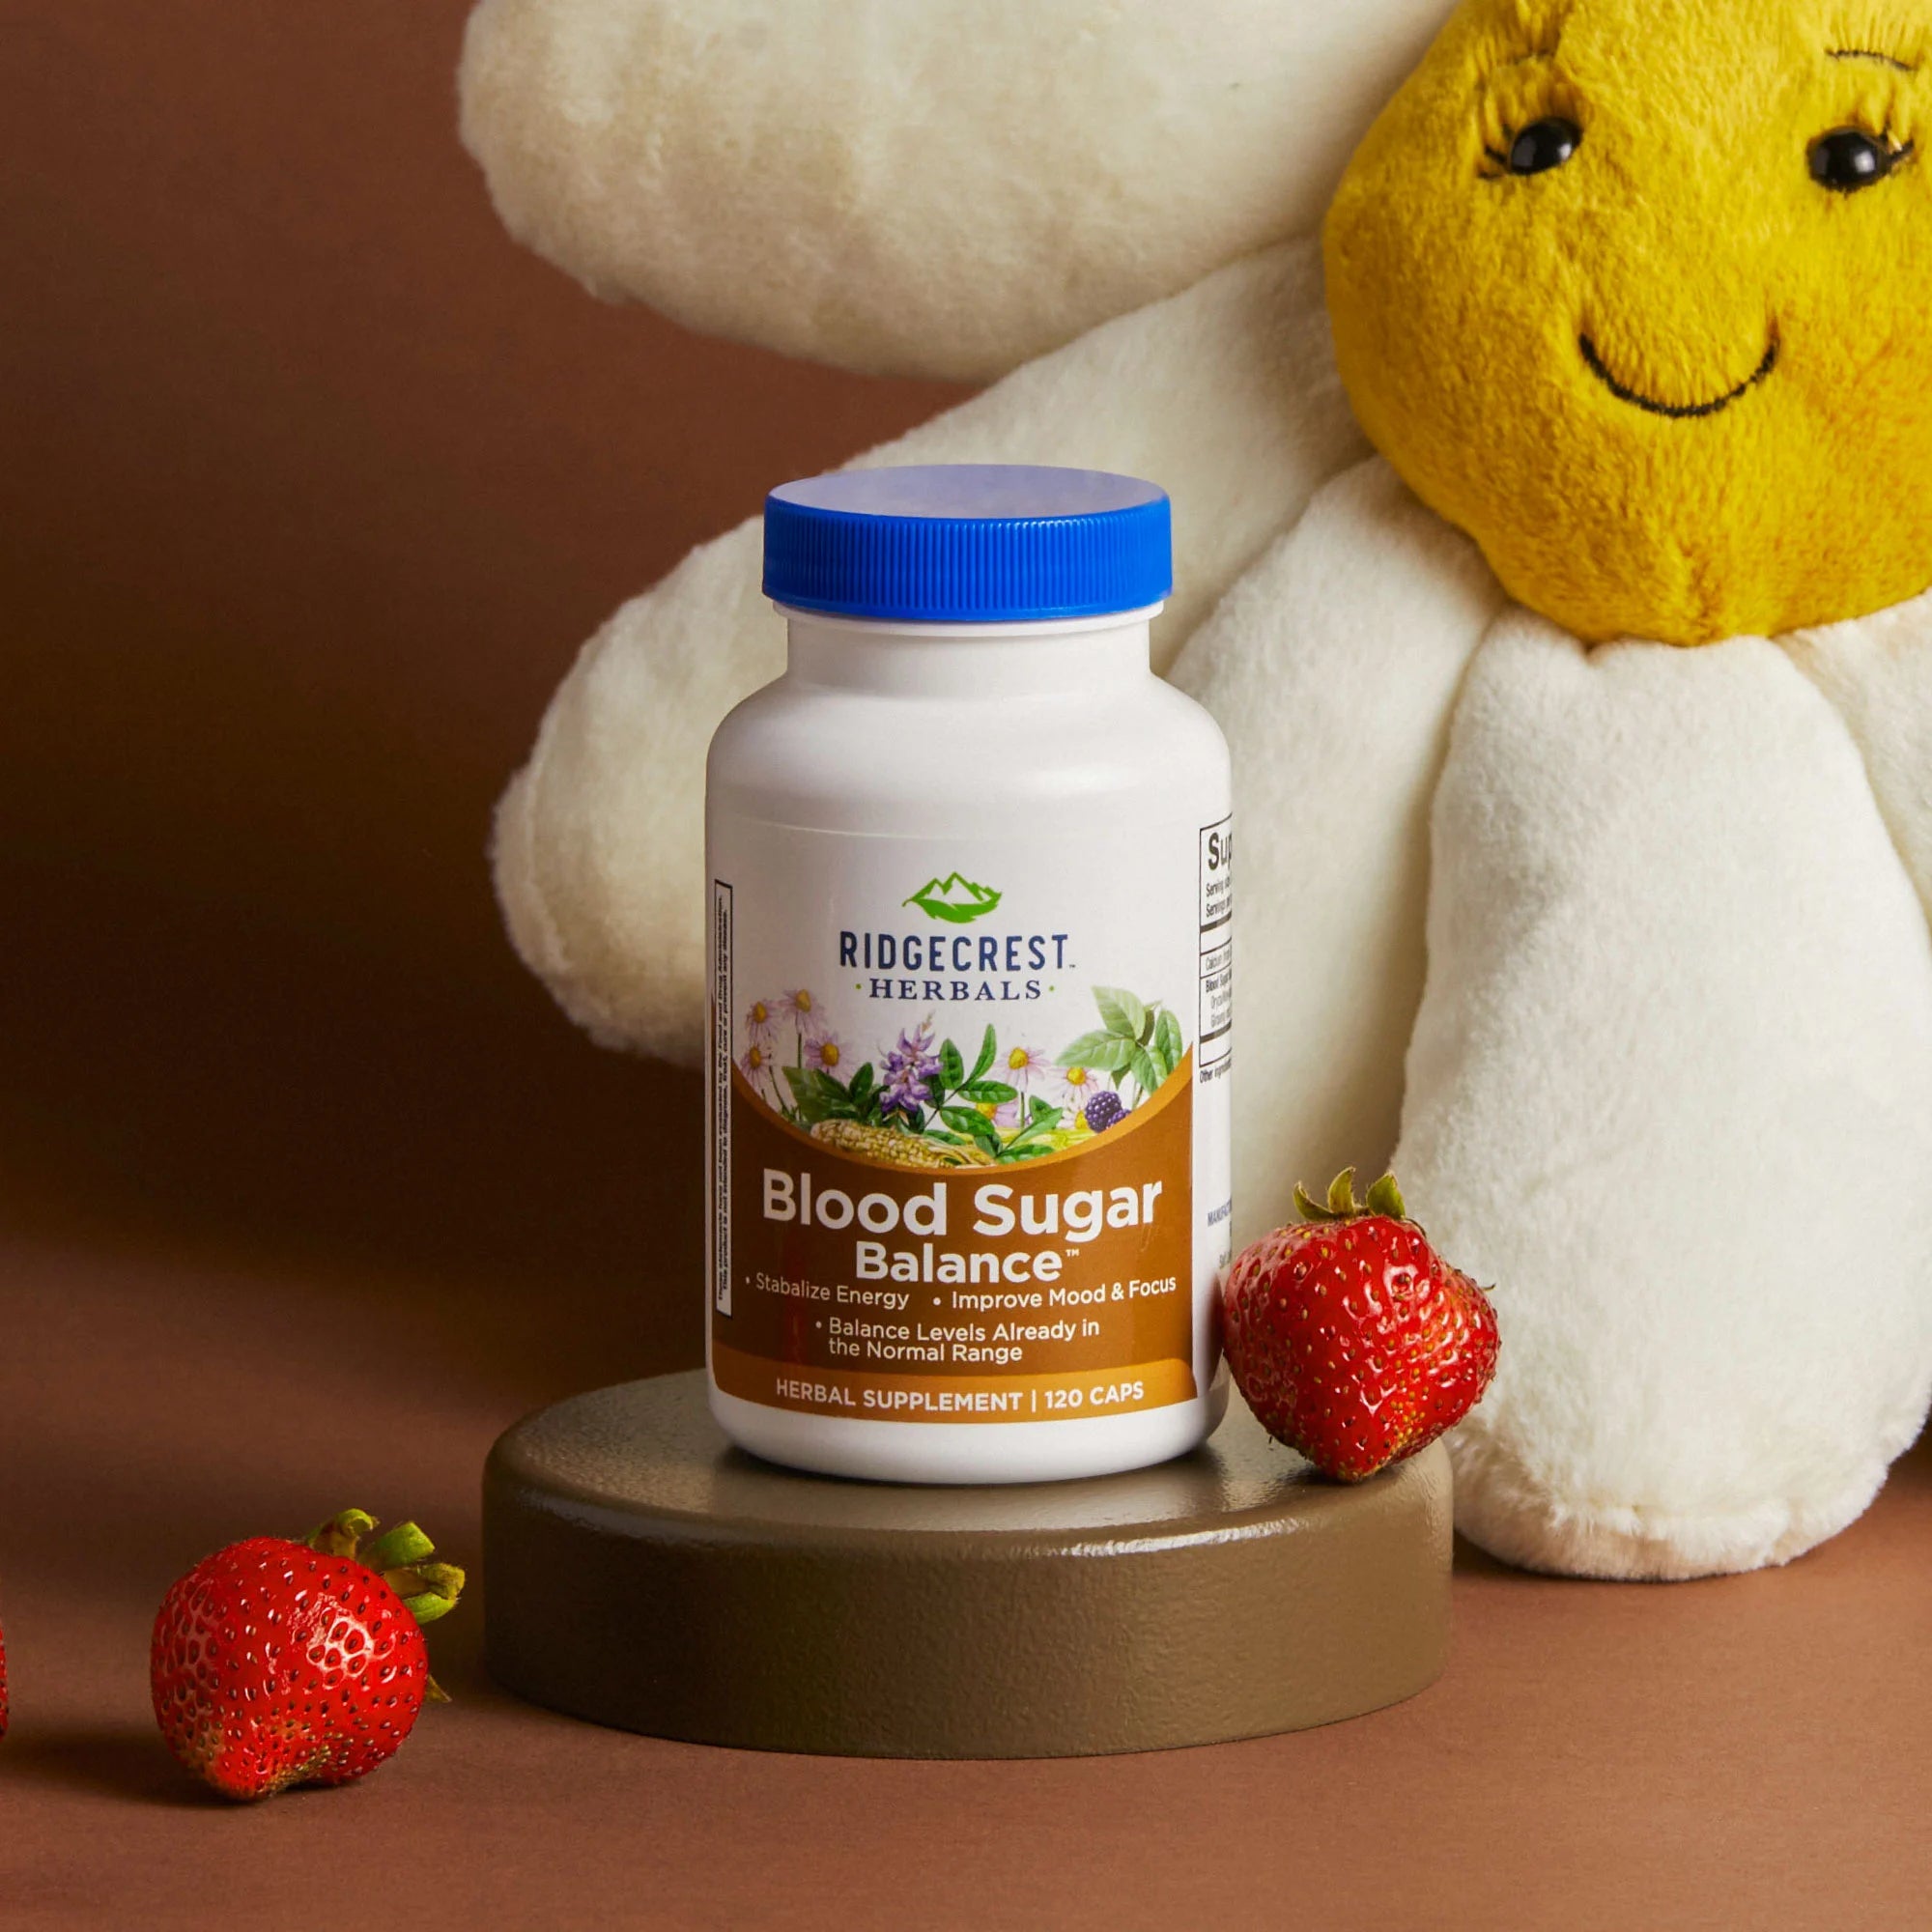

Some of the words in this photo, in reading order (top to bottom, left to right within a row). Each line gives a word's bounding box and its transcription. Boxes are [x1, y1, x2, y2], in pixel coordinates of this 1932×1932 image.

[839, 931, 1068, 972] RIDGECREST
[868, 978, 1041, 1001] HERBALS
[763, 1168, 948, 1236] Blood
[973, 1178, 1163, 1244] Sugar
[755, 1271, 831, 1300] Stabalize
[837, 1286, 910, 1310] Energy
[952, 1291, 1042, 1312] Improve
[1049, 1284, 1106, 1306] Mood
[1111, 1282, 1124, 1301] &
[1128, 1276, 1177, 1298] Focus
[829, 1317, 910, 1340] Balance
[917, 1322, 986, 1342] Levels
[992, 1321, 1077, 1342] Already
[1082, 1319, 1100, 1337] in
[829, 1337, 861, 1356] the
[867, 1340, 945, 1361] Normal
[952, 1344, 1023, 1365] Range
[776, 1378, 856, 1406] HERBAL
[863, 1389, 1024, 1412] SUPPLEMENT
[1044, 1388, 1083, 1409] 120
[1089, 1381, 1145, 1406] CAPS
